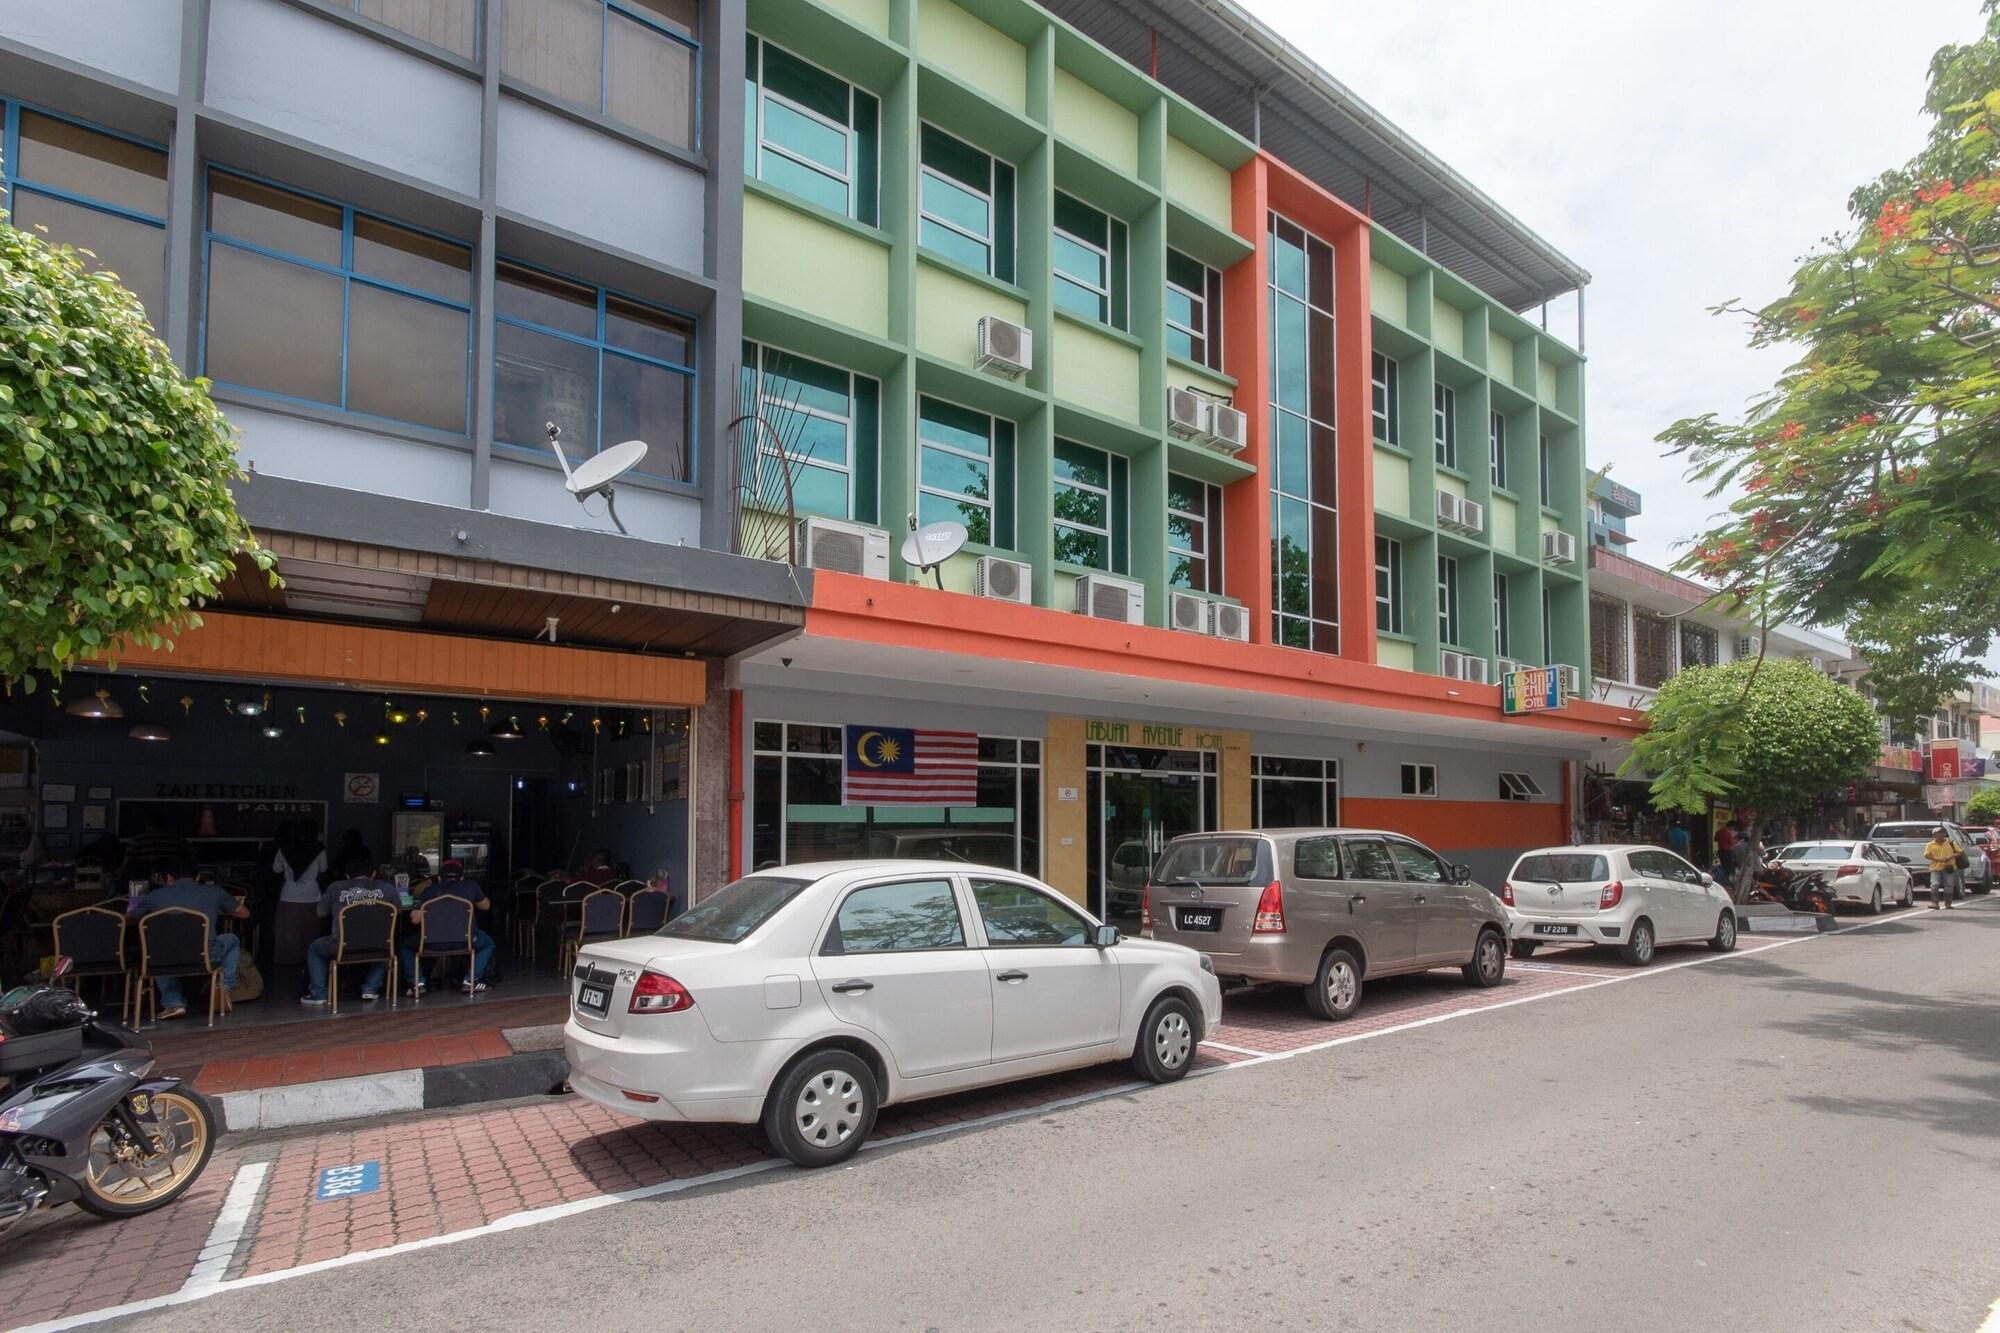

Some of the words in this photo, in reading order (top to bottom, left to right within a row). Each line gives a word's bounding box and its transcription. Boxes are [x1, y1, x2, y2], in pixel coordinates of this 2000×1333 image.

[925, 531, 952, 541] astro
[1085, 720, 1129, 744] LABUAN
[1142, 725, 1184, 747] AVENUE
[1196, 734, 1224, 750] HOTEL
[206, 784, 297, 800] KITCHEN
[237, 803, 313, 813] PARIS
[1184, 914, 1194, 925] LC
[1194, 915, 1212, 926] 4527
